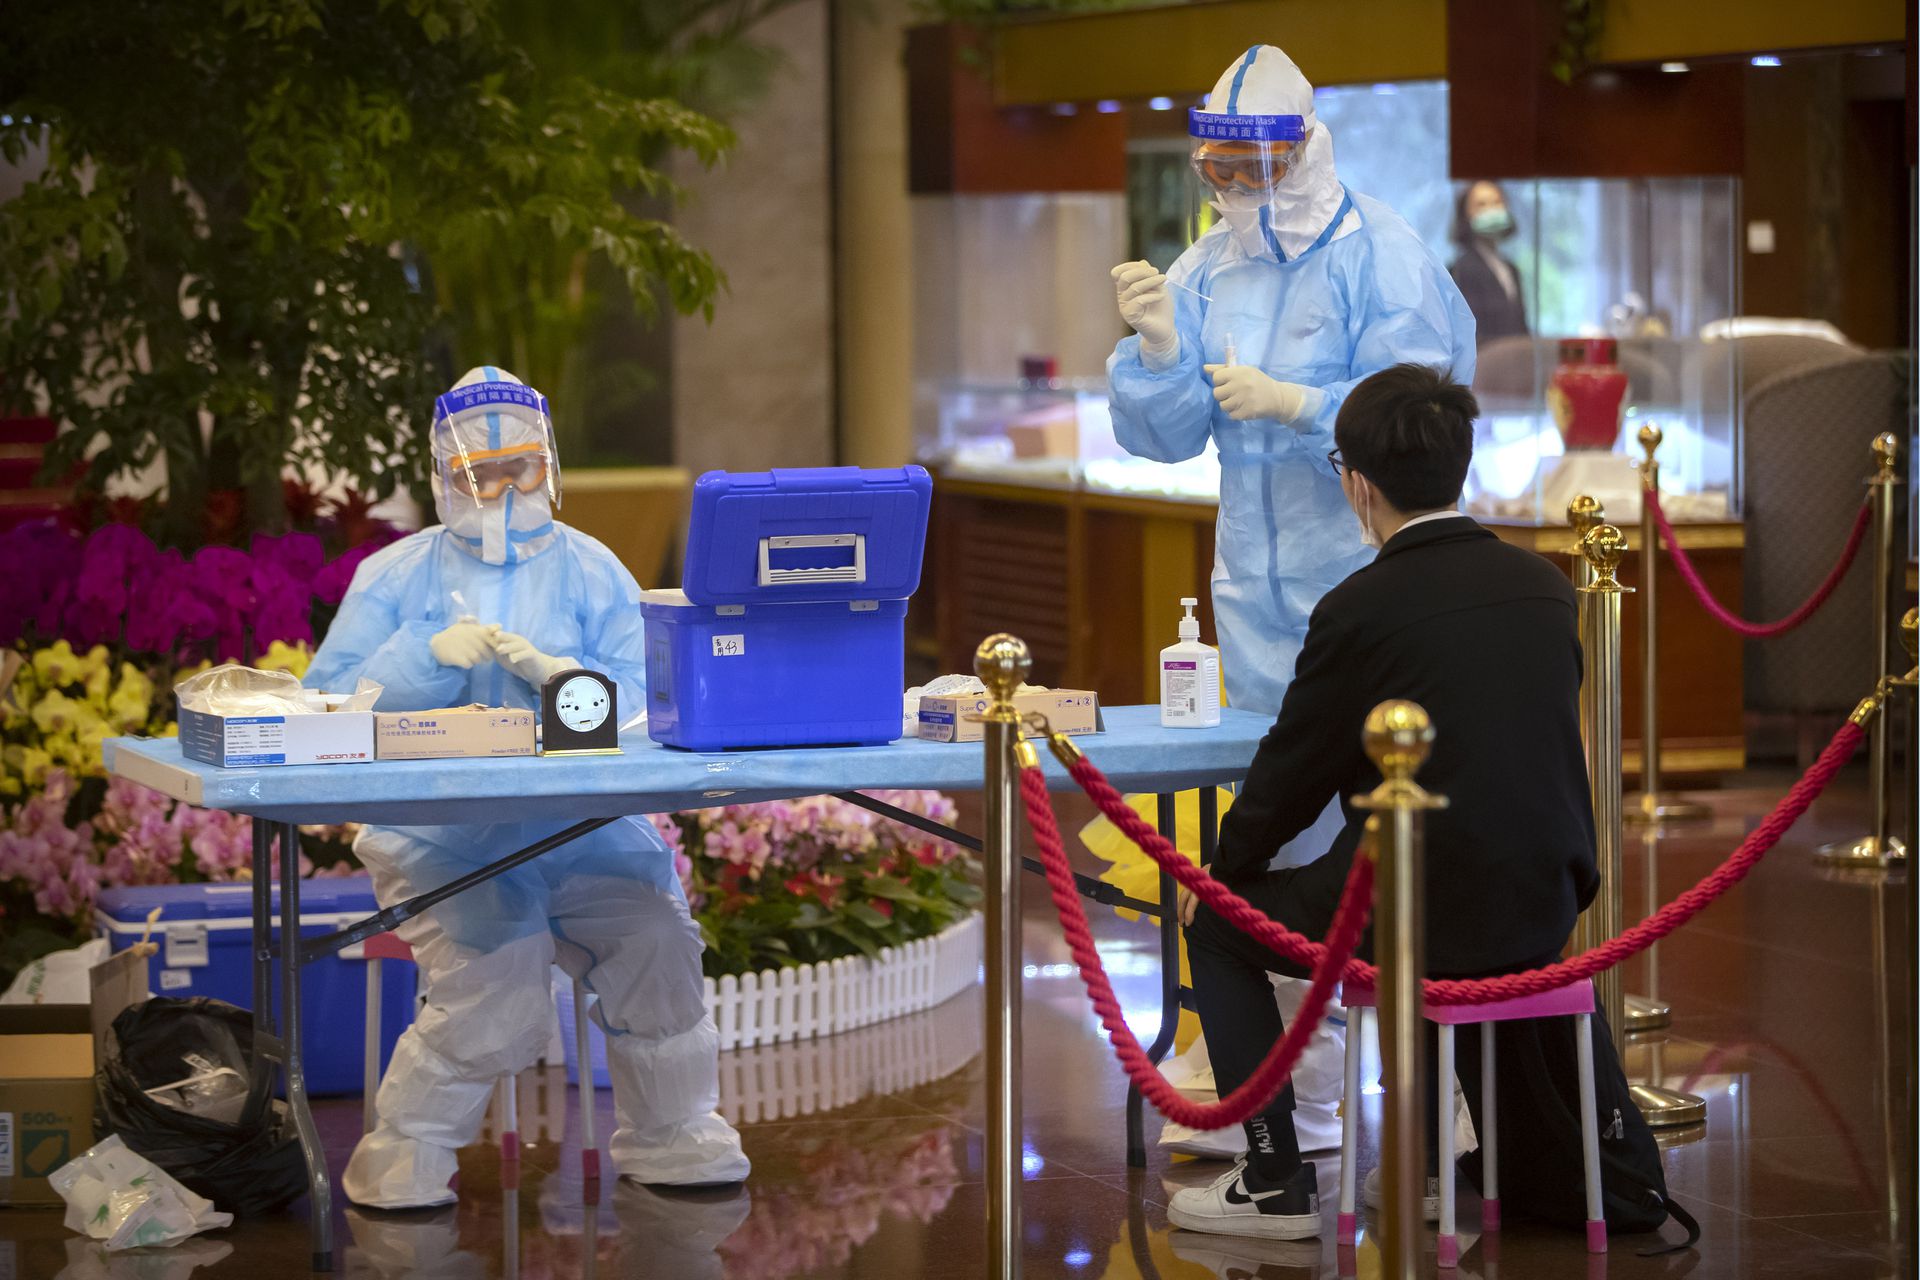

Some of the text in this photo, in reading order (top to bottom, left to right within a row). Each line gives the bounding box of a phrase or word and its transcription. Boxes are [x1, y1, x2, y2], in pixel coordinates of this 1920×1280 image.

[1193, 114, 1277, 126] Medical Protective Mask
[452, 384, 483, 399] Medical
[483, 383, 524, 393] Protective
[959, 704, 976, 712] Super
